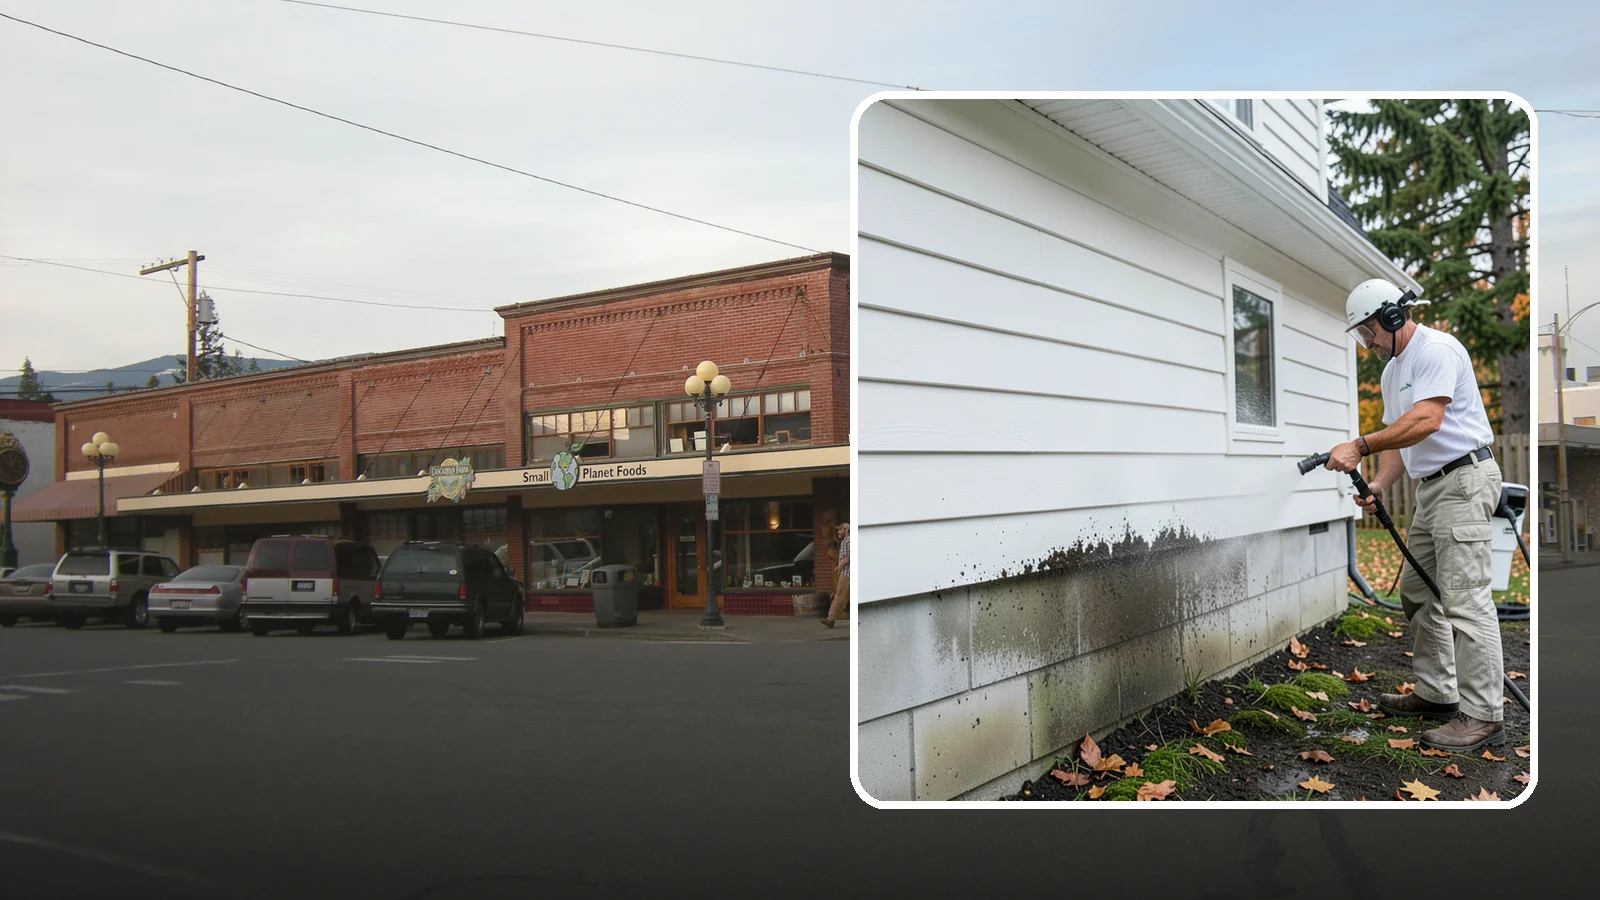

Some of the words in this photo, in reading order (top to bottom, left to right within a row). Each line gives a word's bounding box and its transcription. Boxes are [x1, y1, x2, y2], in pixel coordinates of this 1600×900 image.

[456, 465, 469, 474] FARM
[523, 471, 549, 483] Small
[583, 467, 613, 479] Planet
[617, 465, 647, 477] Foods
